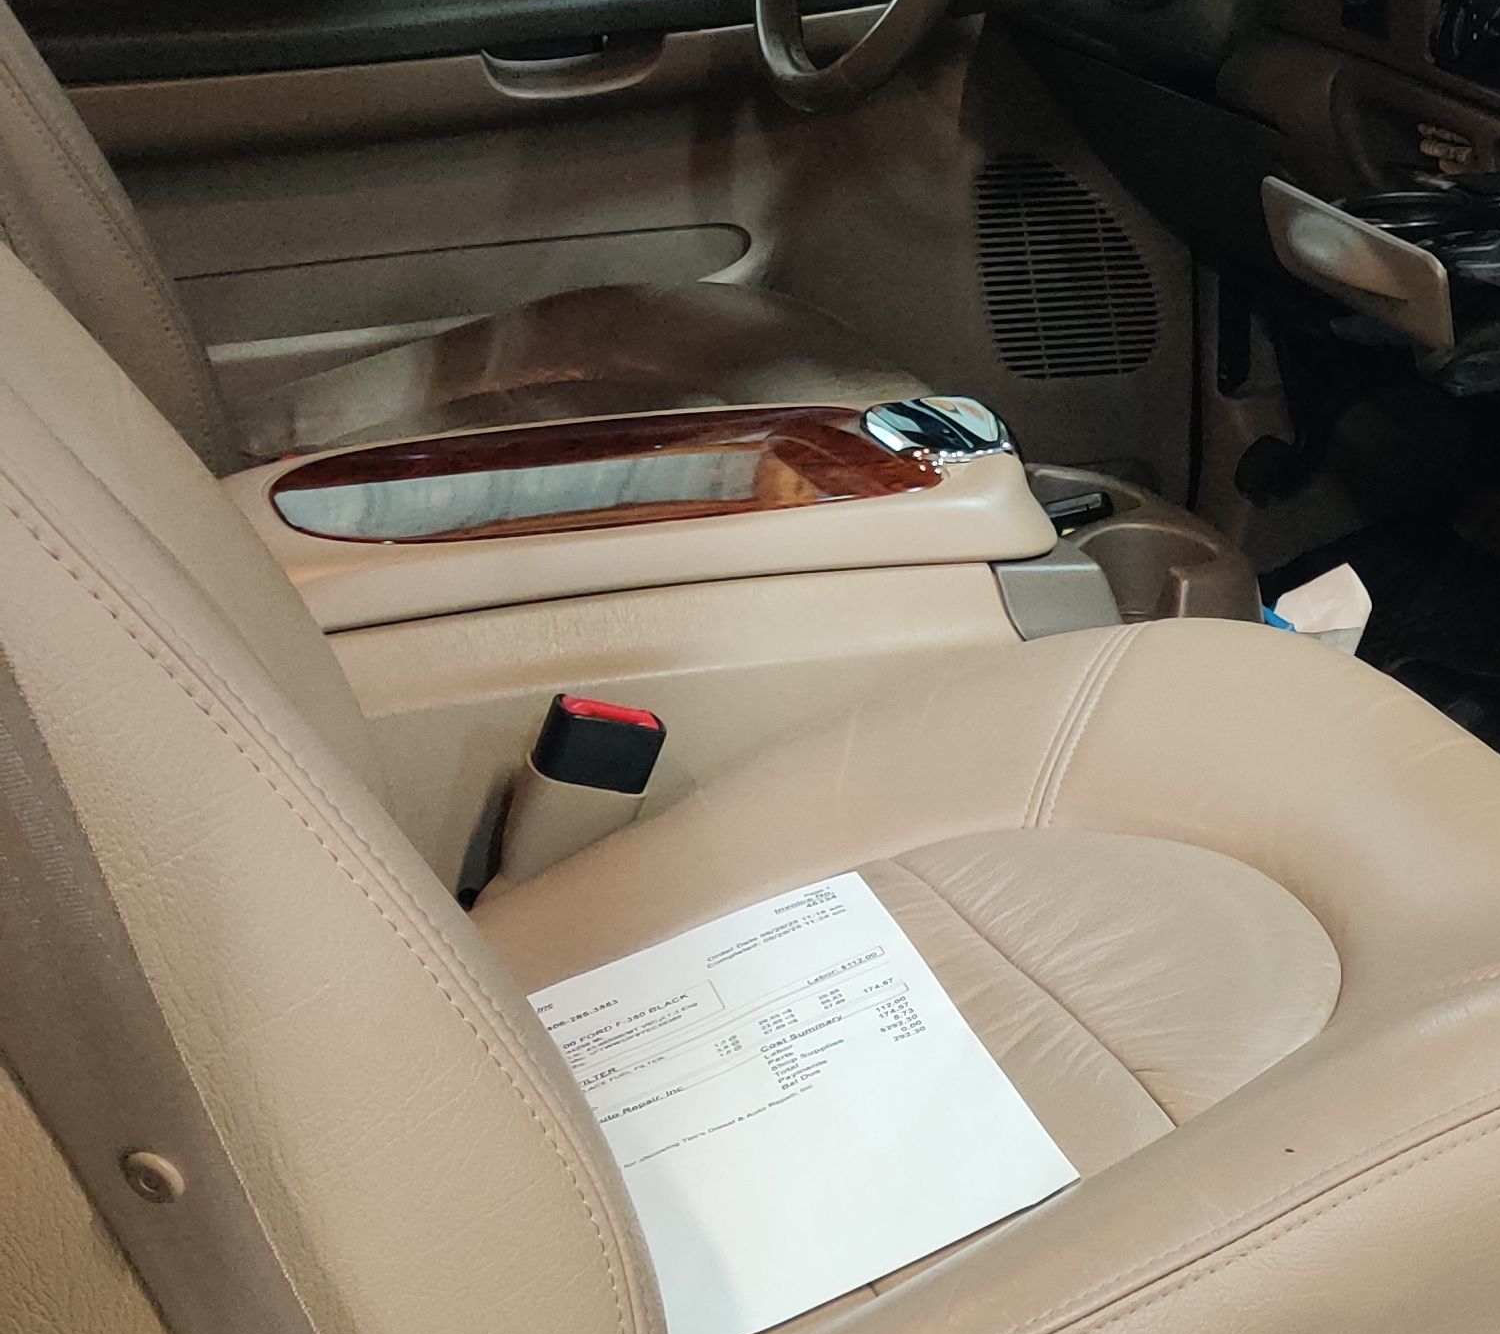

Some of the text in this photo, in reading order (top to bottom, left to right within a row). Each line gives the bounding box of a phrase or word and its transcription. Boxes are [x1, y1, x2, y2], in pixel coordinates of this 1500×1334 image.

[773, 897, 814, 915] Invoice
[875, 995, 907, 1013] 112.00
[579, 1025, 613, 1043] FORD
[648, 994, 689, 1014] BLACK
[760, 1014, 845, 1053] Cost Summary
[799, 1039, 845, 1059] Supplies
